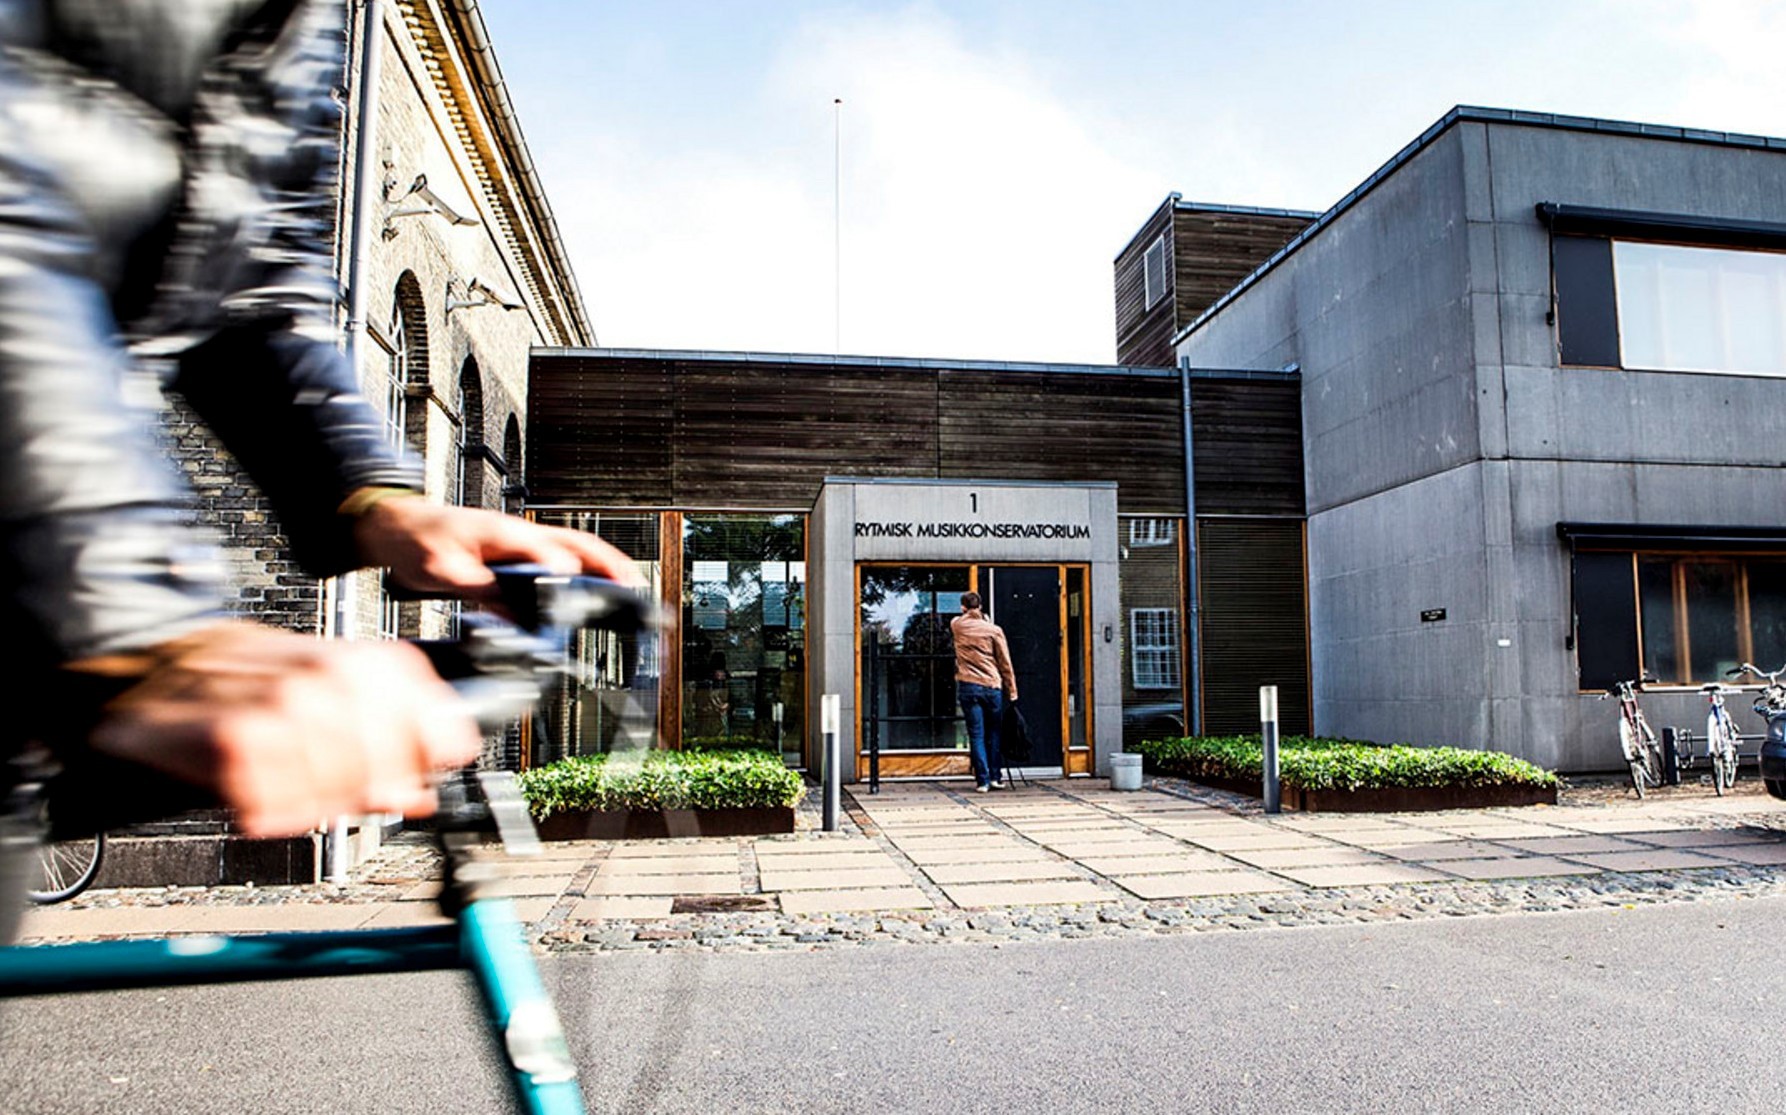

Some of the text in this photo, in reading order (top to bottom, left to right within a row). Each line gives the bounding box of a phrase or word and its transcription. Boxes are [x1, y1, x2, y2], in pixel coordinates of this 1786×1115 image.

[969, 492, 977, 513] 1
[855, 522, 1090, 539] RYTMISK MUSIKKONSERVATORIUM
